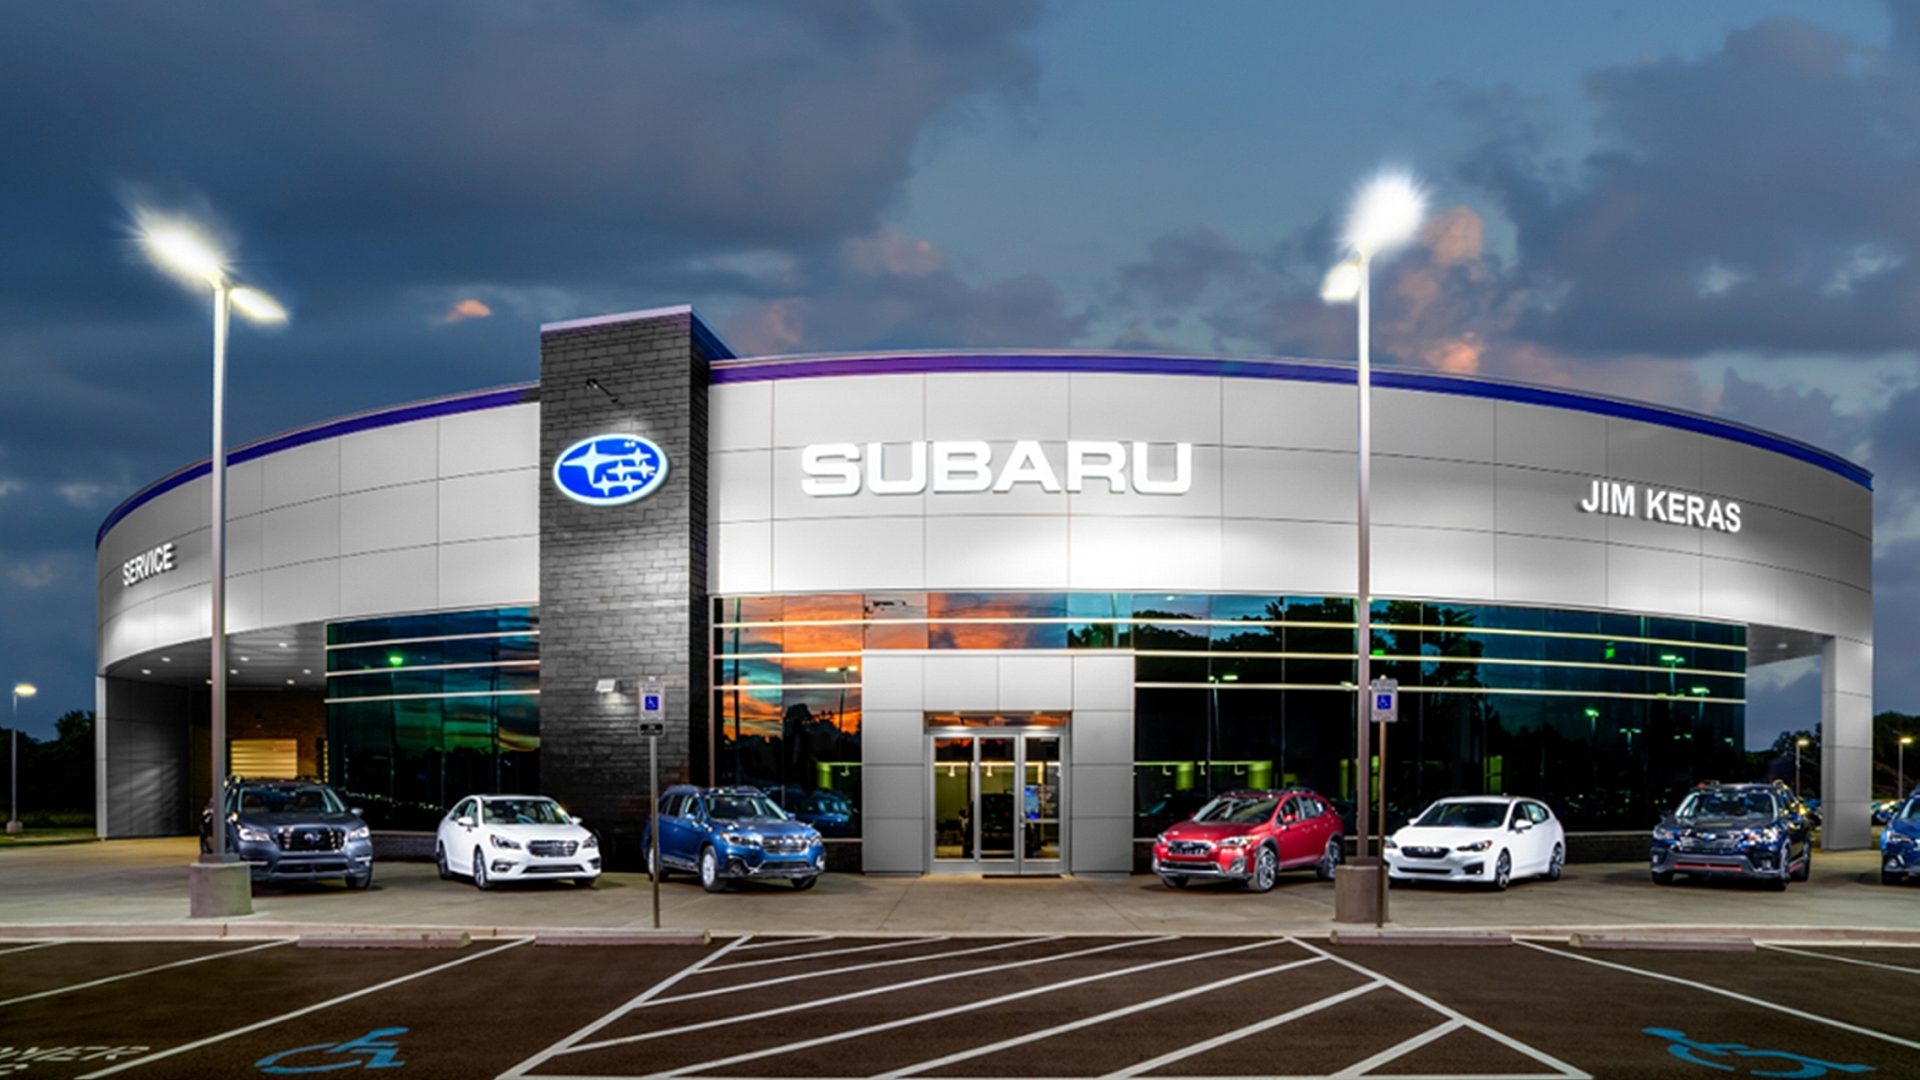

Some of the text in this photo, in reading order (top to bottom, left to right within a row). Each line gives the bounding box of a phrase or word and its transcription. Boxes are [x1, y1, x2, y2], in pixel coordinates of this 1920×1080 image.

[801, 440, 1192, 496] SUBARU
[1581, 480, 1742, 533] JIM KERAS
[122, 542, 174, 587] SERVICE
